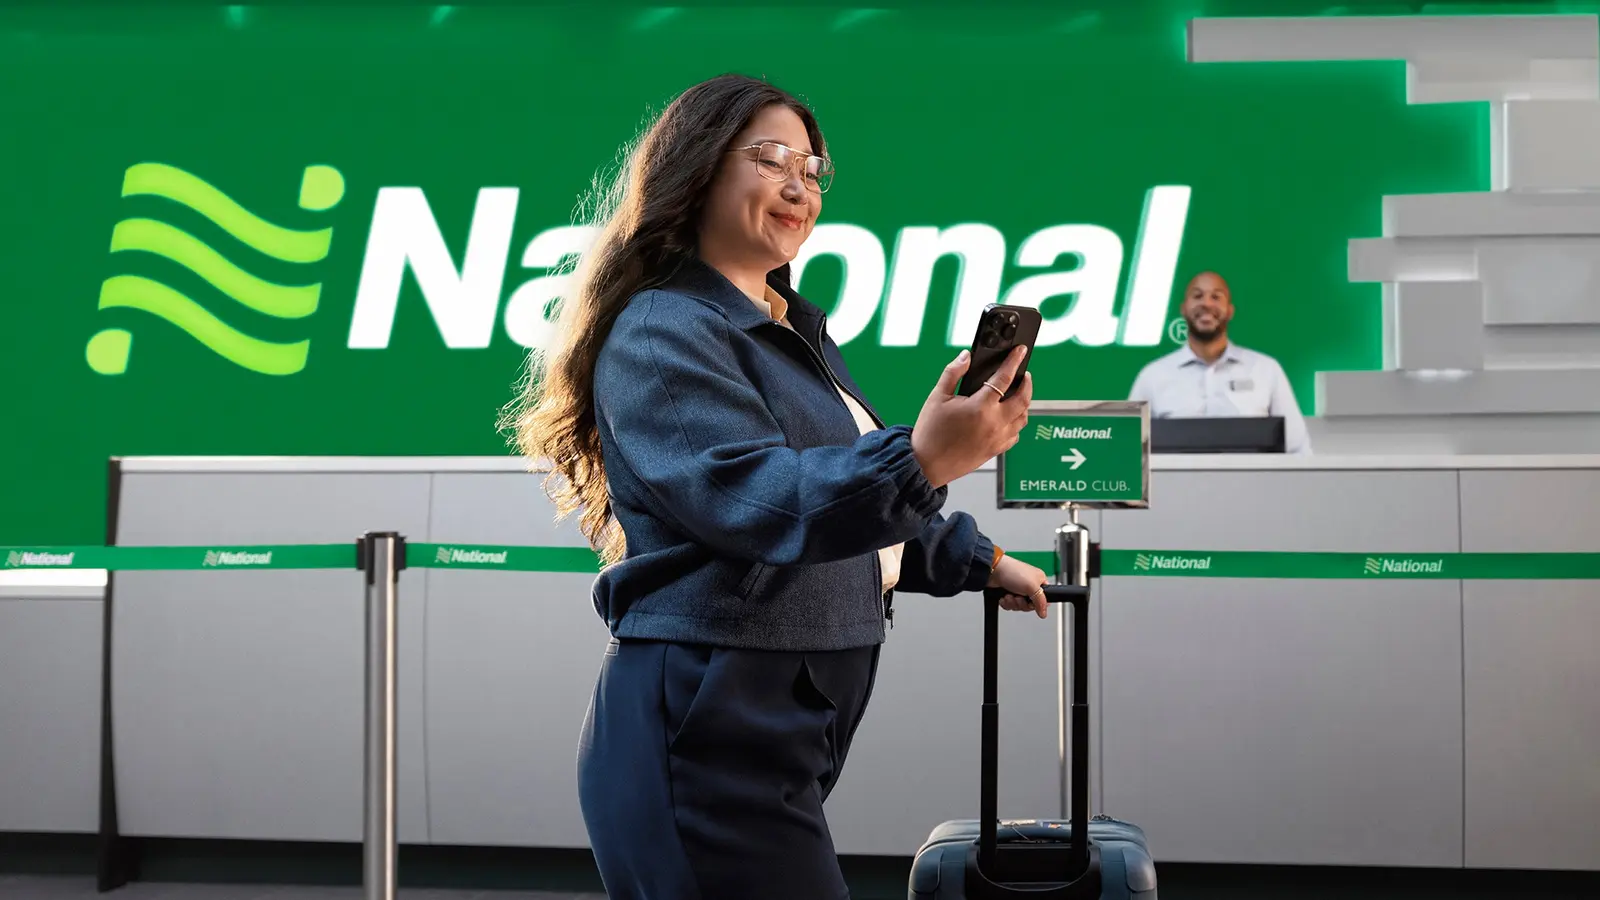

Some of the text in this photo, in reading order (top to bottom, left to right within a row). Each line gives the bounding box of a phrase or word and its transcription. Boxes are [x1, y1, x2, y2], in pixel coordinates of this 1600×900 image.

[1020, 480, 1087, 491] EMERALD
[20, 552, 75, 565] National
[217, 551, 272, 565] National
[451, 549, 507, 564] National
[1151, 556, 1211, 569] National
[1382, 559, 1443, 573] National
